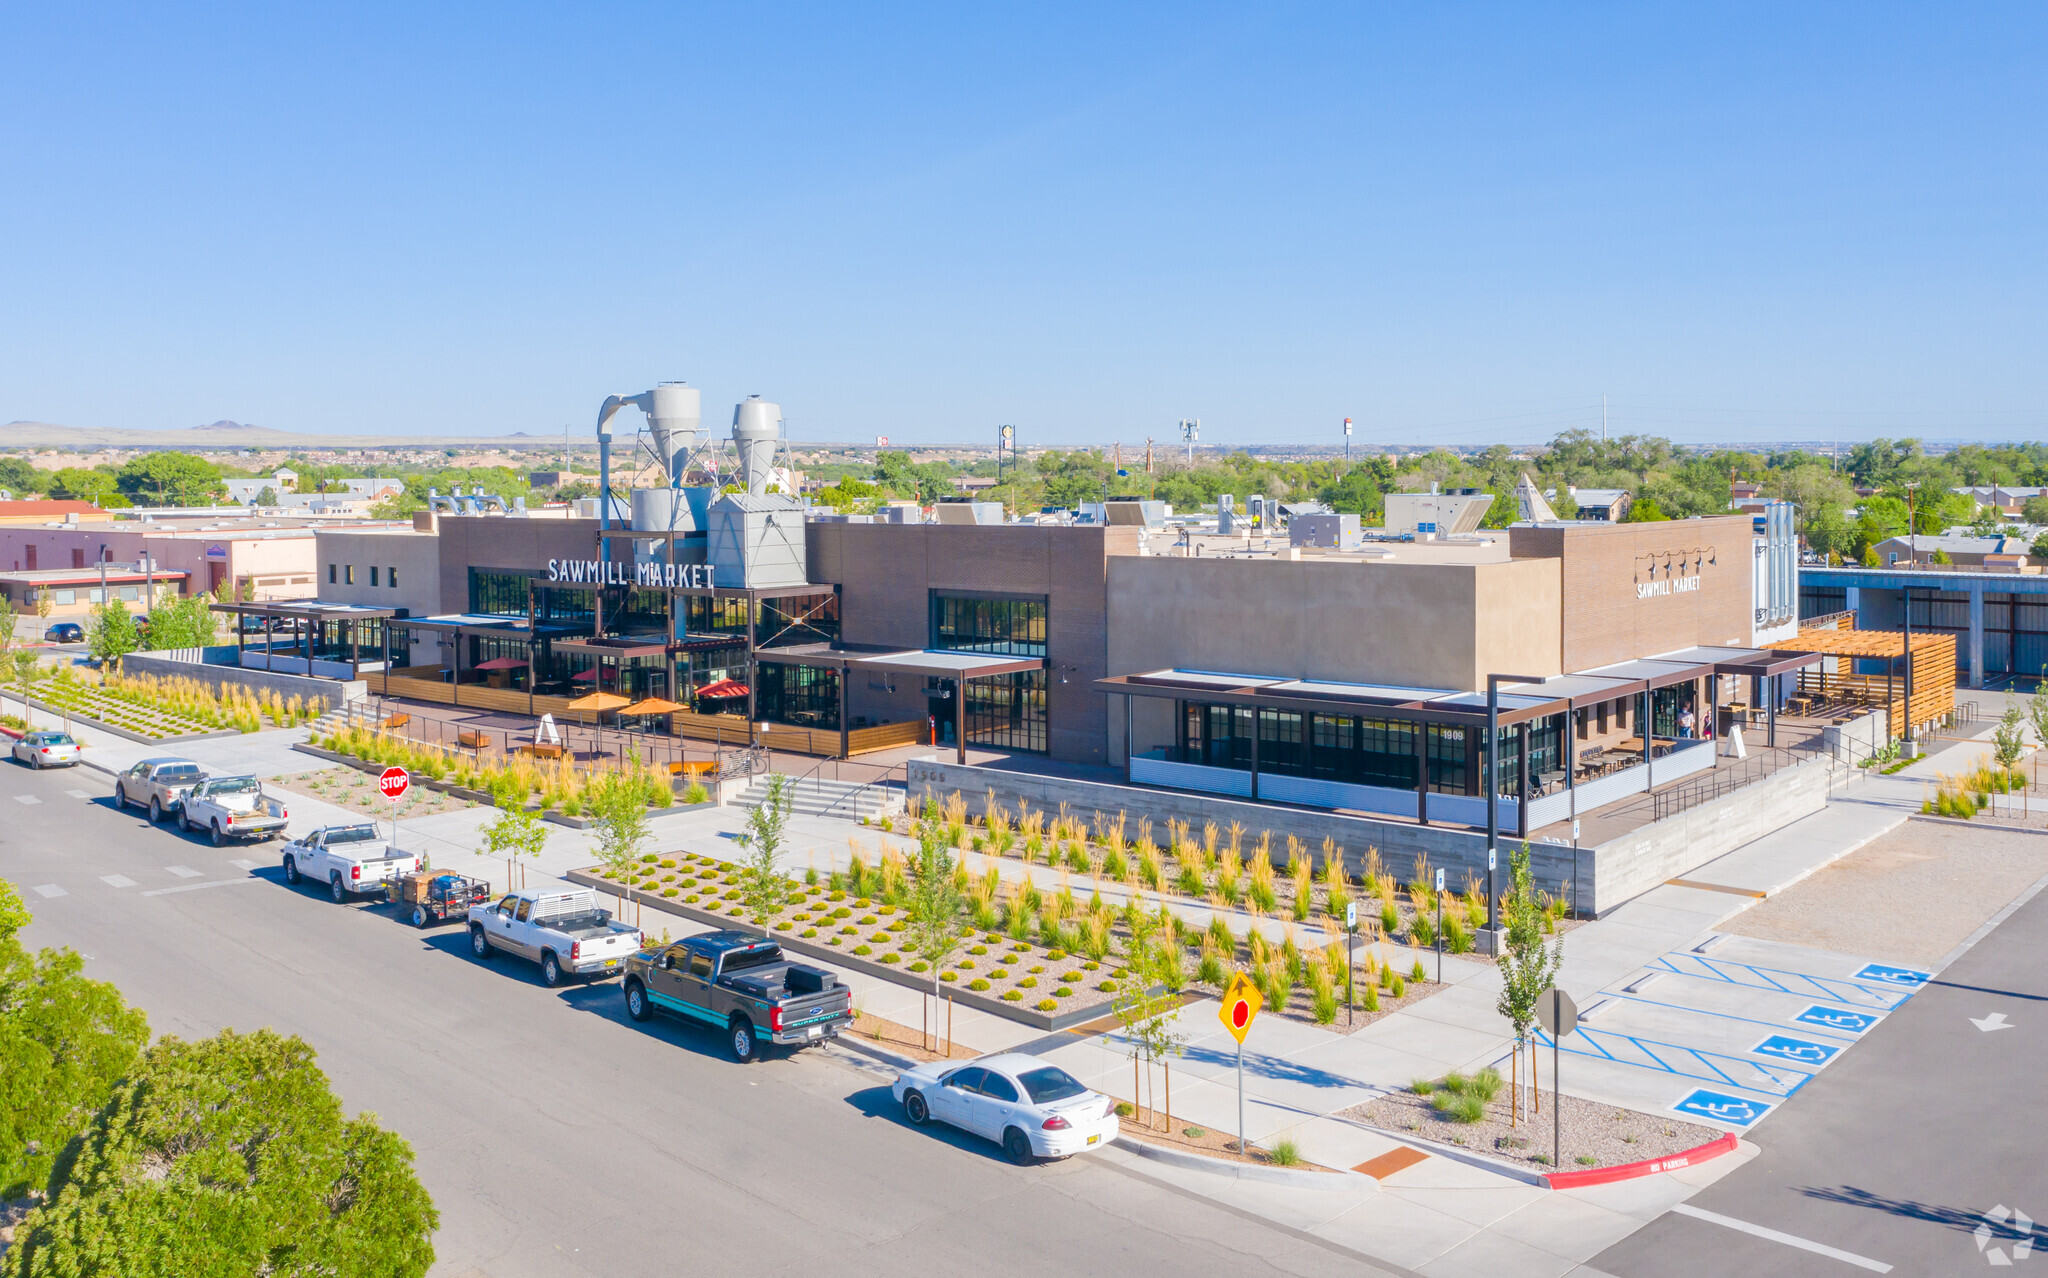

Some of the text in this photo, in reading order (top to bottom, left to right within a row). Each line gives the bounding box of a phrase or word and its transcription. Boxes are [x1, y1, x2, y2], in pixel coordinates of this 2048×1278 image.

[548, 559, 715, 589] SAWMILL MARKET
[1637, 576, 1700, 599] SAWMILL MARKET
[1443, 730, 1464, 741] 1909
[381, 775, 407, 790] STOP
[1650, 1158, 1689, 1172] NO PARKING
